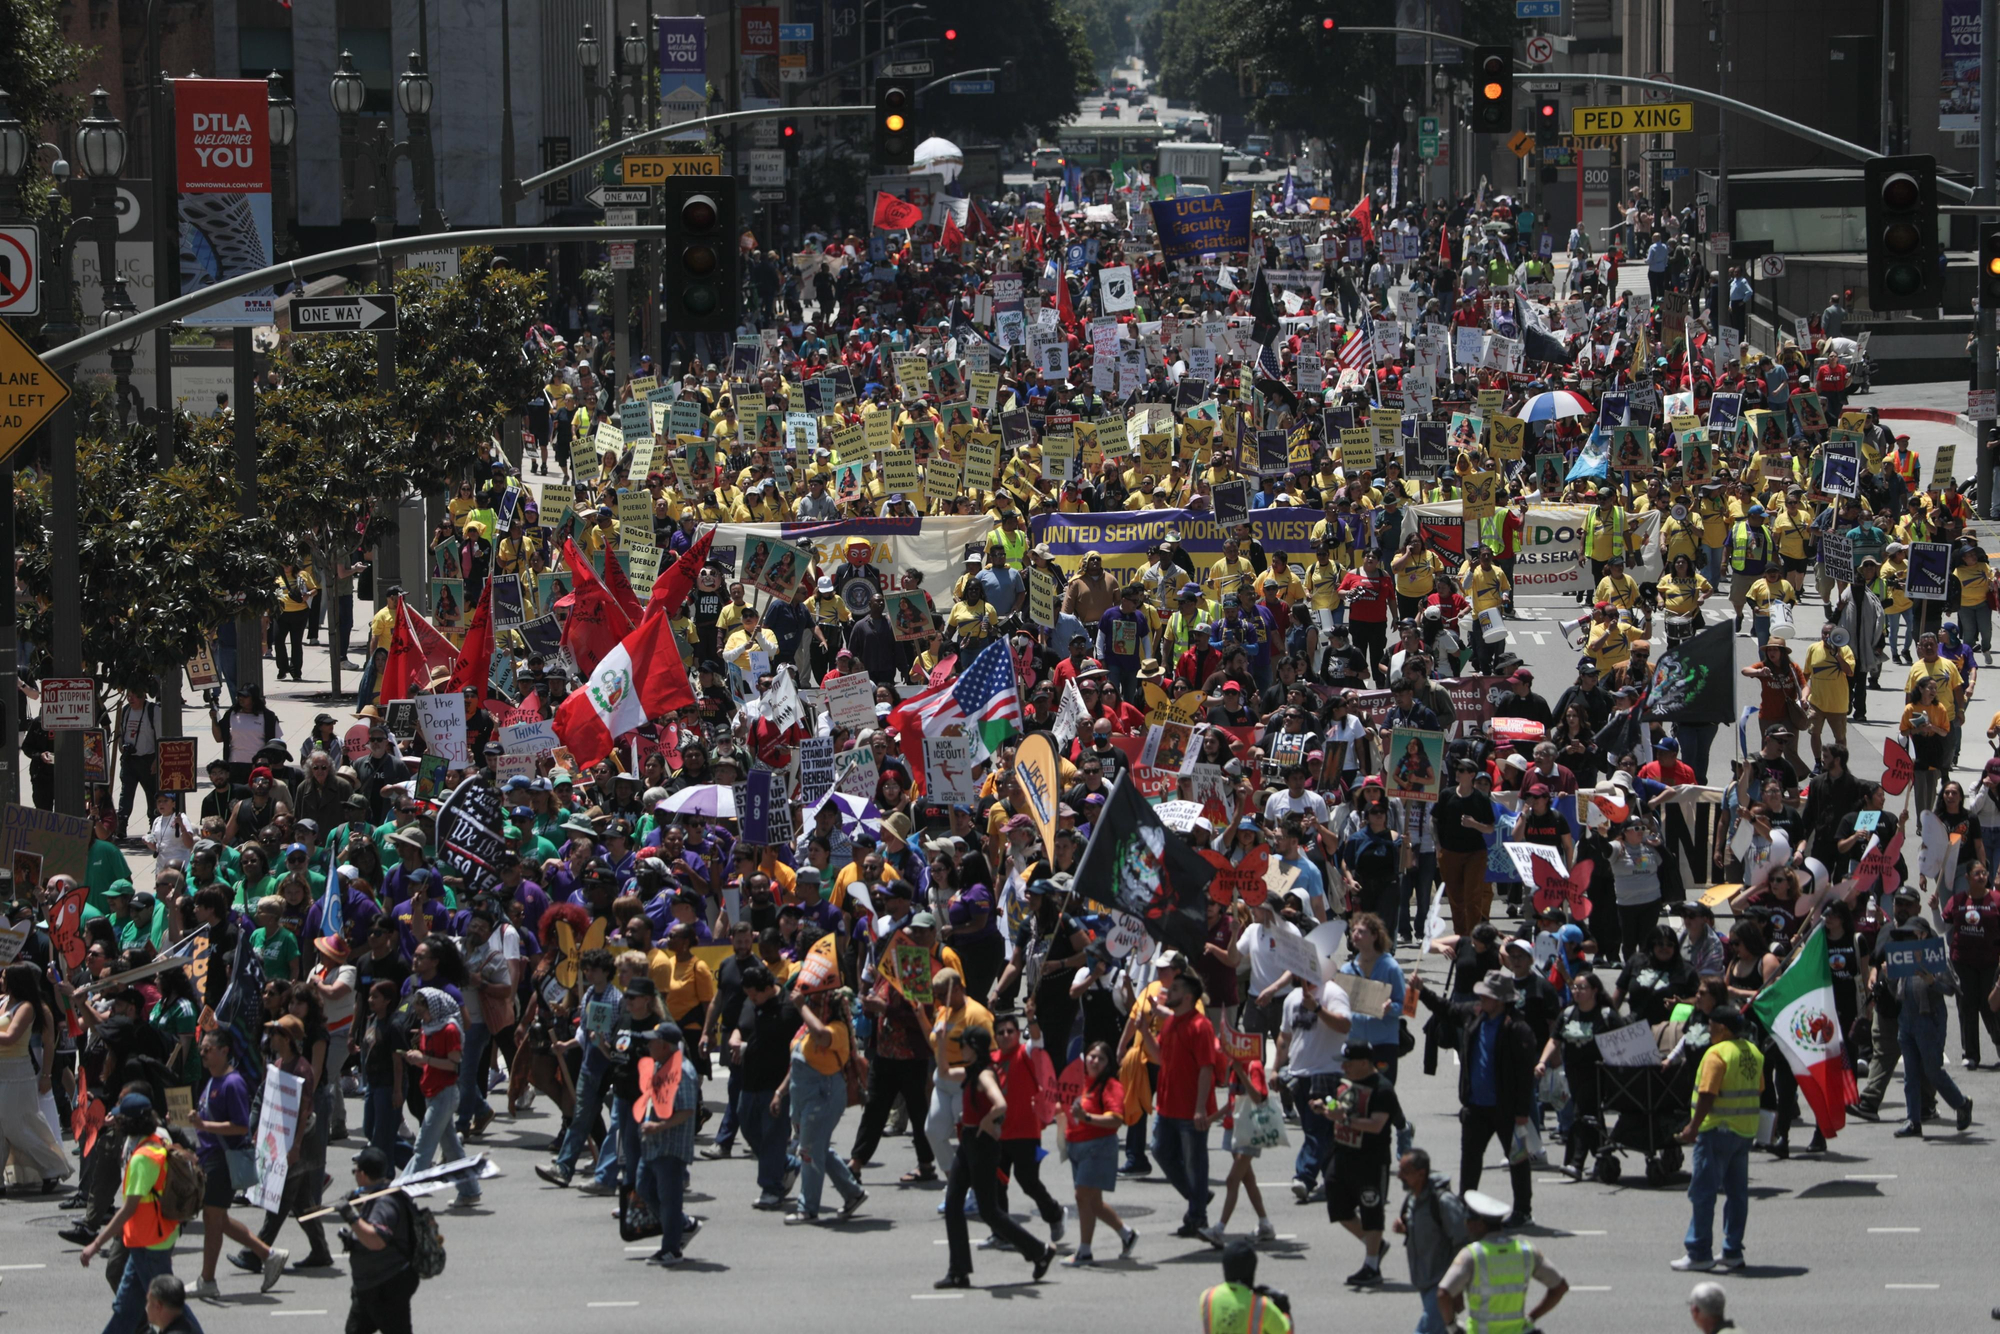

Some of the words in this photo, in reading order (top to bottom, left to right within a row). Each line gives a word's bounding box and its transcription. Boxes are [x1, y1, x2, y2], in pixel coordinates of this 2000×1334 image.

[1523, 3, 1538, 14] 6th
[1542, 2, 1554, 14] St
[747, 21, 771, 29] DTLA
[668, 34, 696, 44] DTLA
[749, 34, 773, 45] YOU
[1952, 34, 1981, 45] YOU
[669, 50, 697, 62] YOU
[892, 64, 906, 74] ONE
[912, 64, 928, 73] WAY
[193, 113, 251, 132] DTLA
[1584, 111, 1623, 130] PED
[1633, 108, 1681, 127] XING
[755, 128, 778, 136] BLOCK
[194, 134, 252, 145] WELCOMES
[195, 148, 253, 168] YOU
[630, 163, 664, 177] PED
[672, 162, 713, 176] XING
[755, 163, 779, 172] MUST
[1585, 170, 1609, 183] 800
[605, 192, 624, 201] ONE
[626, 191, 644, 201] WAY
[1176, 199, 1225, 216] UCLA
[1173, 216, 1231, 236] Faculty
[82, 259, 139, 272] PULIC
[418, 261, 447, 272] MUST
[994, 280, 1022, 289] STOP
[1667, 293, 1687, 313] STOP
[302, 308, 330, 323] ONE
[336, 306, 364, 321] WAY
[9, 394, 45, 407] LEFT
[623, 411, 646, 419] PUEBLO
[1773, 468, 1784, 476] ICE
[1420, 516, 1447, 526] JUSTICE
[1449, 517, 1461, 526] FOR
[1042, 523, 1101, 545] UNITED
[1104, 520, 1175, 543] SERVICE
[1266, 518, 1316, 541] WEST
[1824, 540, 1844, 549] STAND
[1843, 543, 1852, 552] UP
[1831, 548, 1852, 559] TRUMP
[1825, 555, 1852, 571] GENERAL
[1515, 570, 1578, 585] ENCIDOS
[1826, 566, 1853, 583] STRIKE!
[1911, 585, 1942, 594] JANITORS
[700, 596, 718, 604] HEAD
[700, 605, 717, 614] LICE
[523, 619, 541, 631] JUSTICE
[43, 690, 56, 701] NO
[59, 691, 91, 700] STOPPING
[46, 704, 65, 714] ANY
[69, 705, 90, 714] TIME
[416, 699, 428, 711] We
[435, 698, 453, 708] the
[1157, 701, 1187, 717] PROTECT
[504, 710, 535, 718] PROTECT
[424, 713, 461, 732] People
[434, 732, 452, 740] are
[508, 723, 542, 740] THINK
[802, 740, 825, 748] MAY
[802, 749, 824, 759] STAND
[824, 748, 832, 756] UP
[934, 751, 945, 759] ICE
[946, 748, 965, 759] OUT!
[802, 761, 811, 769] TO
[812, 759, 833, 768] TRUMP
[802, 770, 835, 785] GENERAL
[44, 813, 88, 838] DIVIDE
[447, 851, 472, 875] 250
[1859, 863, 1892, 877] FAMILIES
[1544, 887, 1583, 905] FAMILIES
[1960, 925, 1984, 933] CHIRLA
[1887, 951, 1914, 965] ICE
